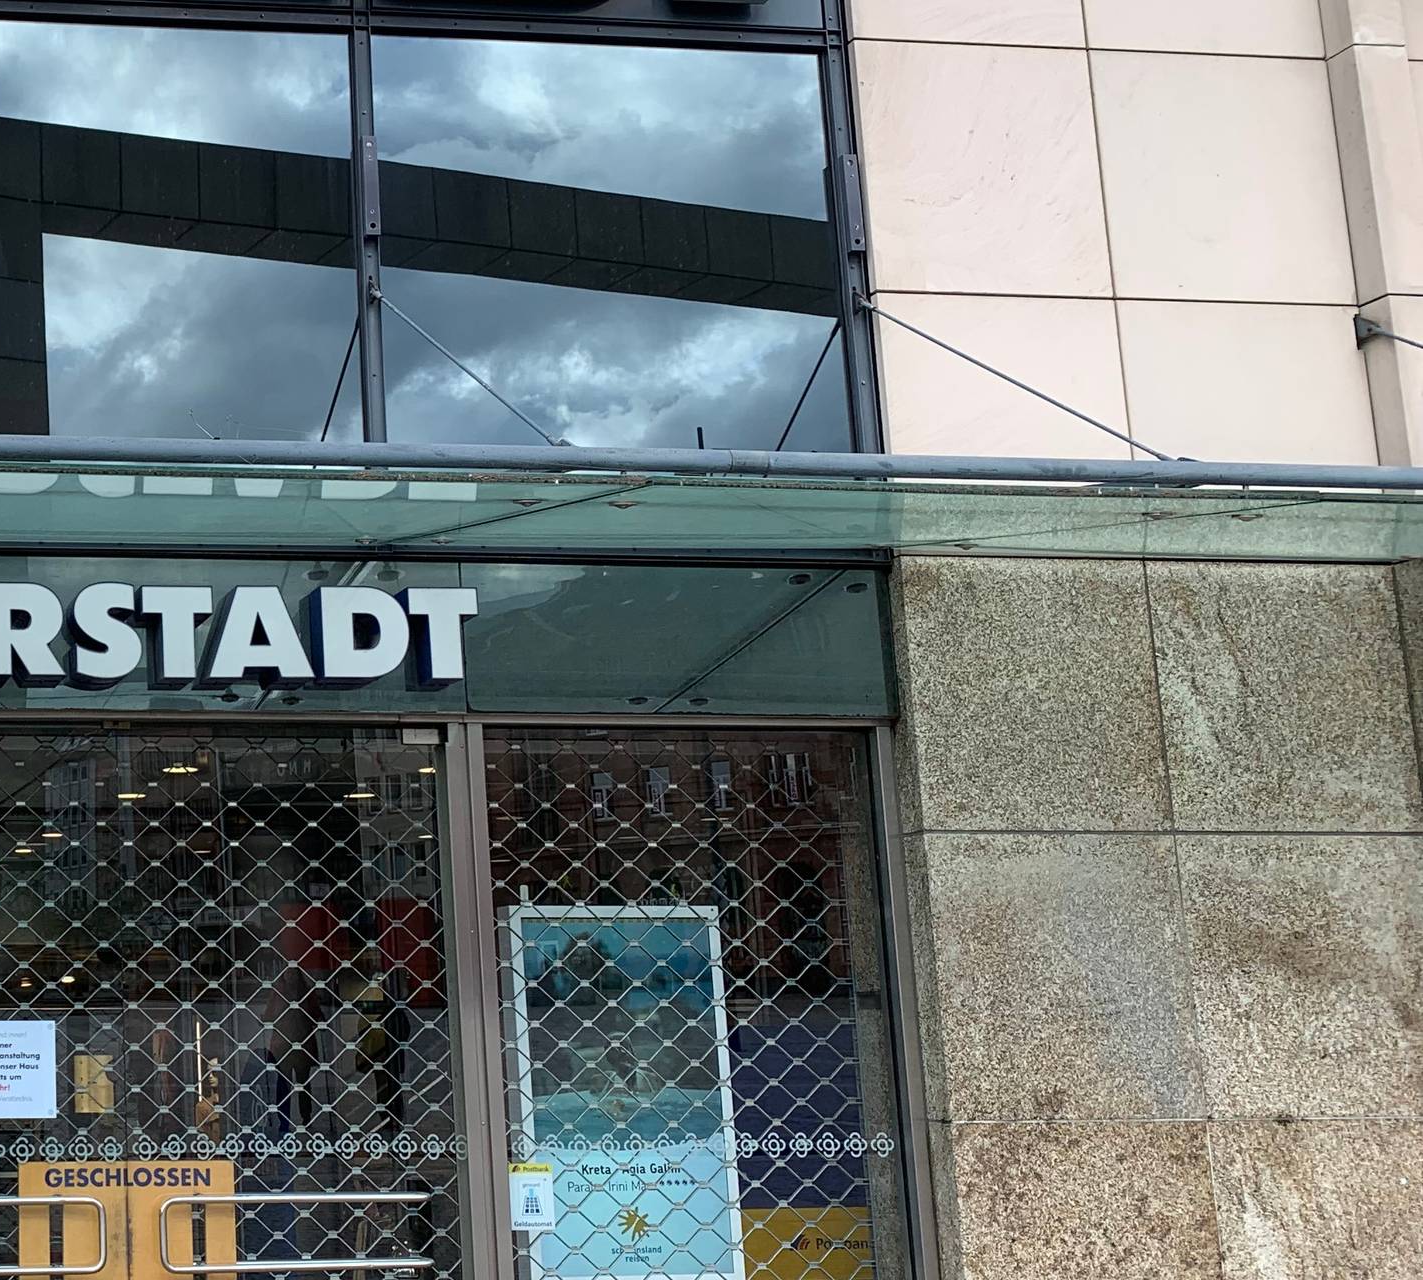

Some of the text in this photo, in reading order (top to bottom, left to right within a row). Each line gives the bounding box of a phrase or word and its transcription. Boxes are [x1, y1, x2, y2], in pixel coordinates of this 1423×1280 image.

[581, 1164, 612, 1175] Kreta
[44, 1168, 210, 1187] GESCHLOSSEN
[608, 1181, 628, 1192] Irini
[816, 1236, 875, 1250] Poban
